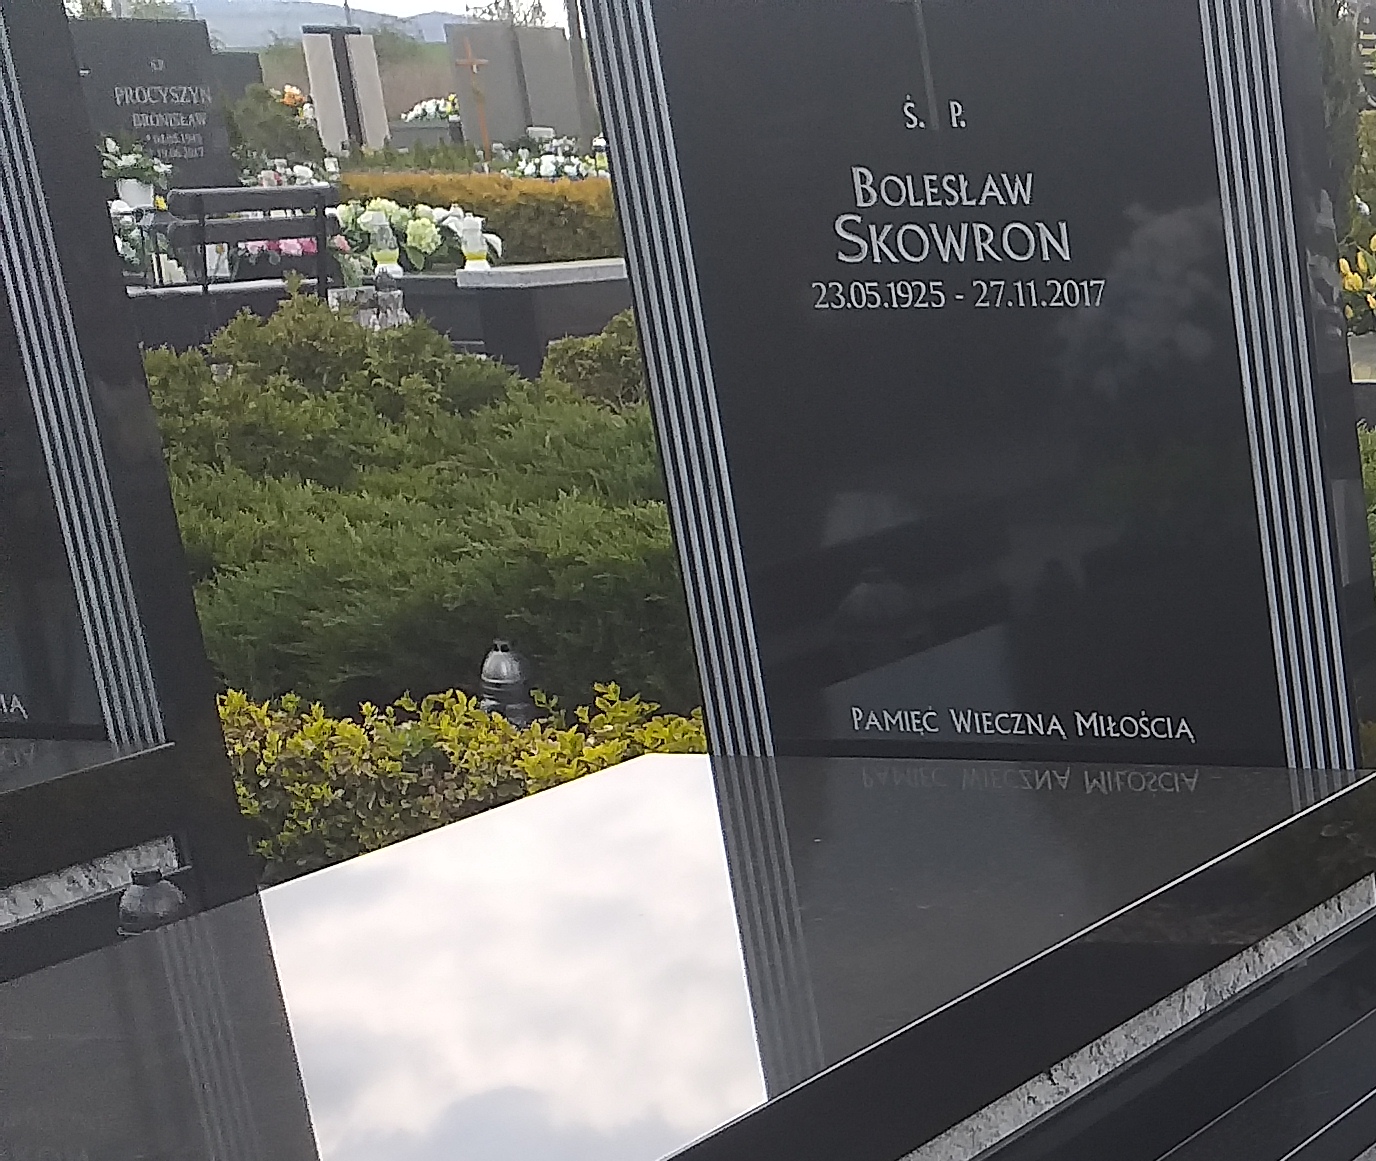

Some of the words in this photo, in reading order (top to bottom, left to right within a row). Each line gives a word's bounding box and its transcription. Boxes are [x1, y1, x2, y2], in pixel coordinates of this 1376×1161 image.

[903, 94, 926, 129] Ś.
[949, 100, 967, 128] P.
[850, 165, 1034, 208] BOLESŁAW
[833, 213, 1071, 264] SKOWRON
[811, 281, 946, 309] 23.05.1925
[972, 279, 1106, 308] 27.11.2017
[851, 705, 940, 736] PAMIĘĆ
[949, 708, 1068, 740] WIECZNĄ
[1073, 709, 1196, 744] MIŁOŚCIĄ
